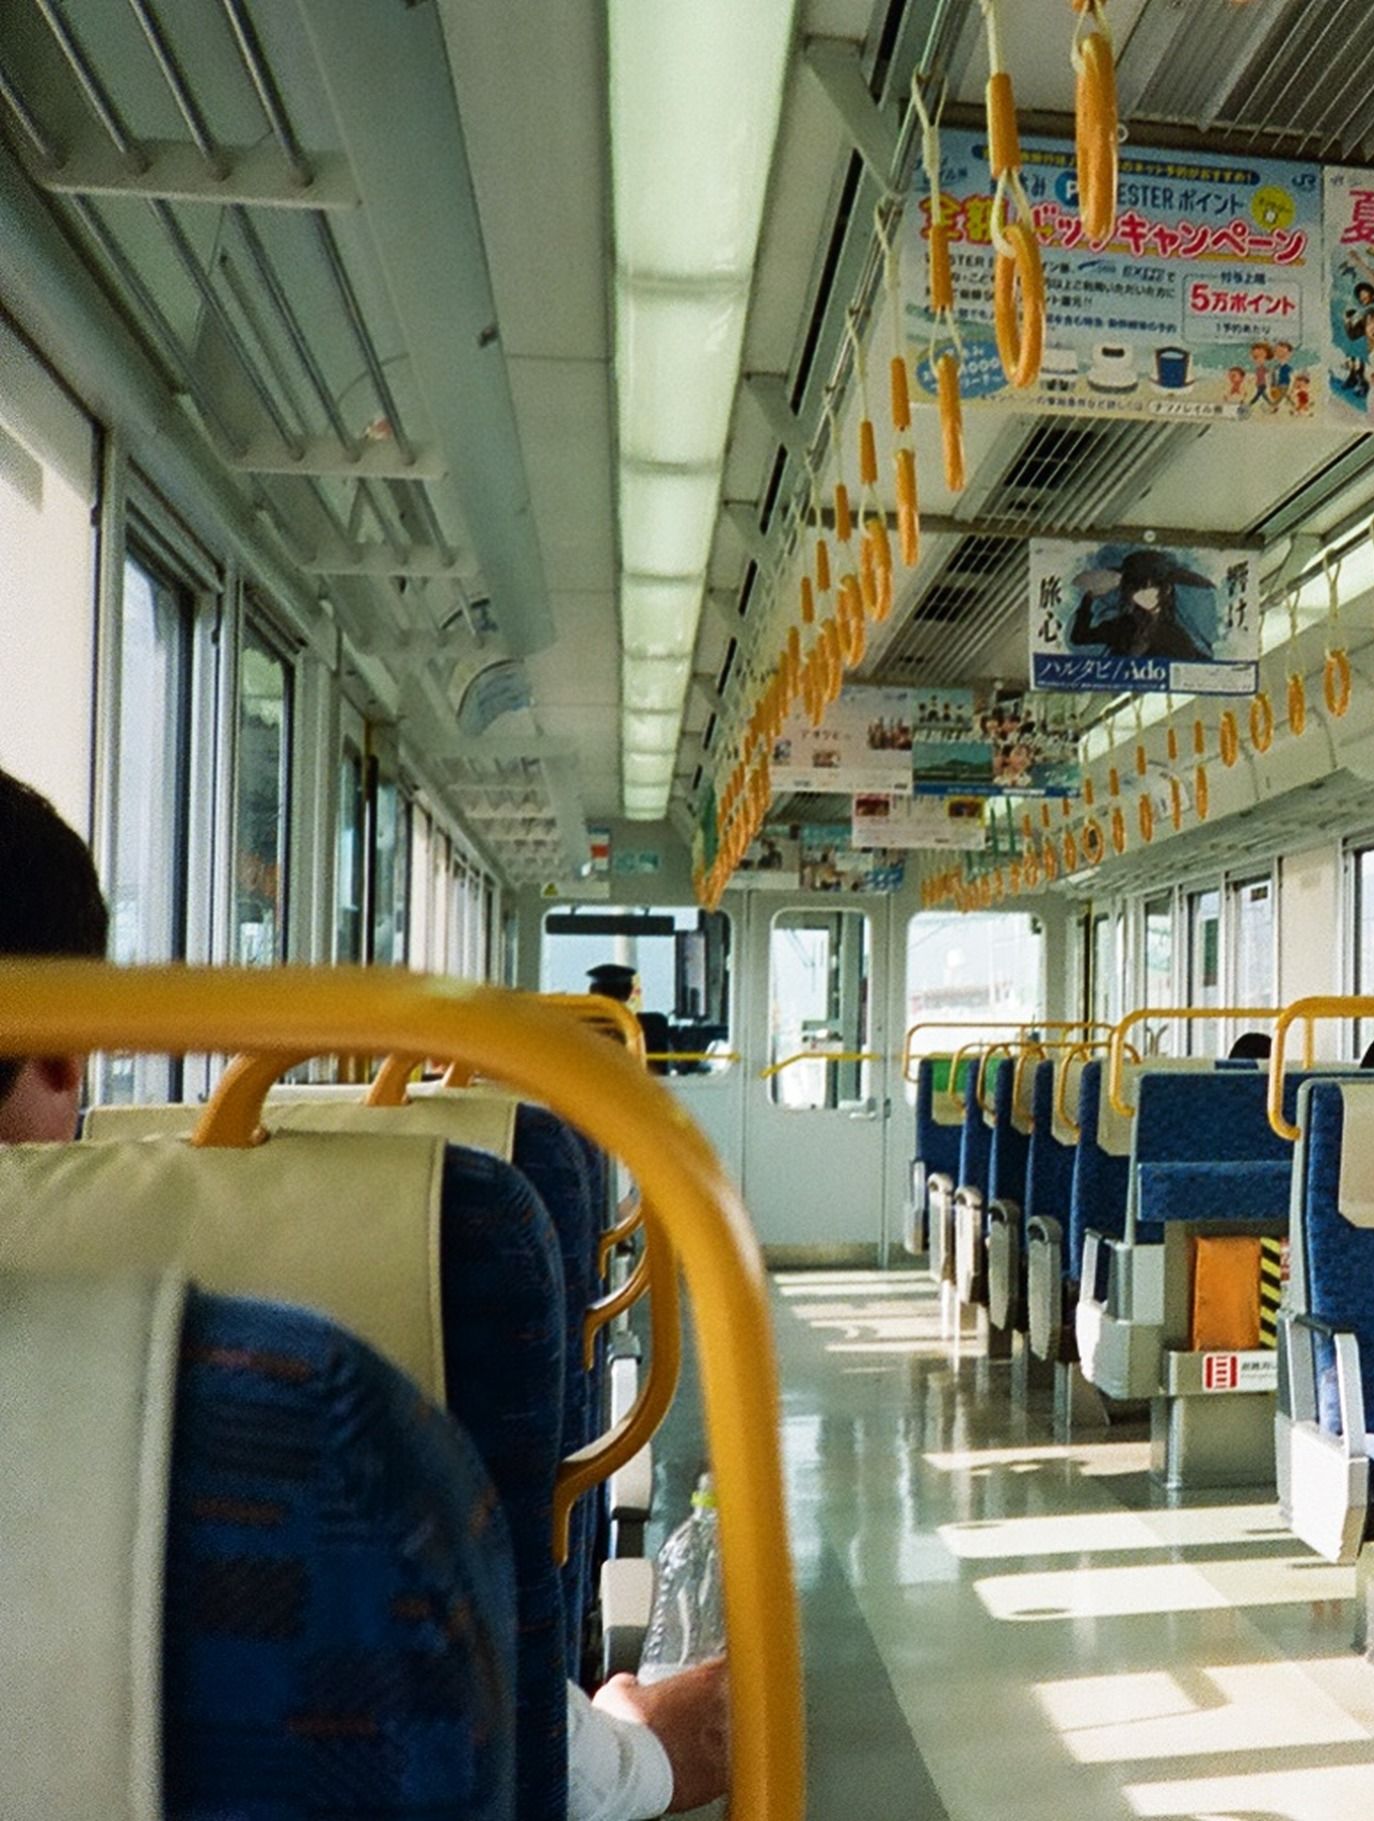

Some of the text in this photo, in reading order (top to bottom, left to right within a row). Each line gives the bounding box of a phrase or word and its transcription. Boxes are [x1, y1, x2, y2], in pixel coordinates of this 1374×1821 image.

[1117, 183, 1173, 212] ESTER
[1179, 190, 1244, 215] ポイント
[1190, 283, 1295, 316] 5万ポイント
